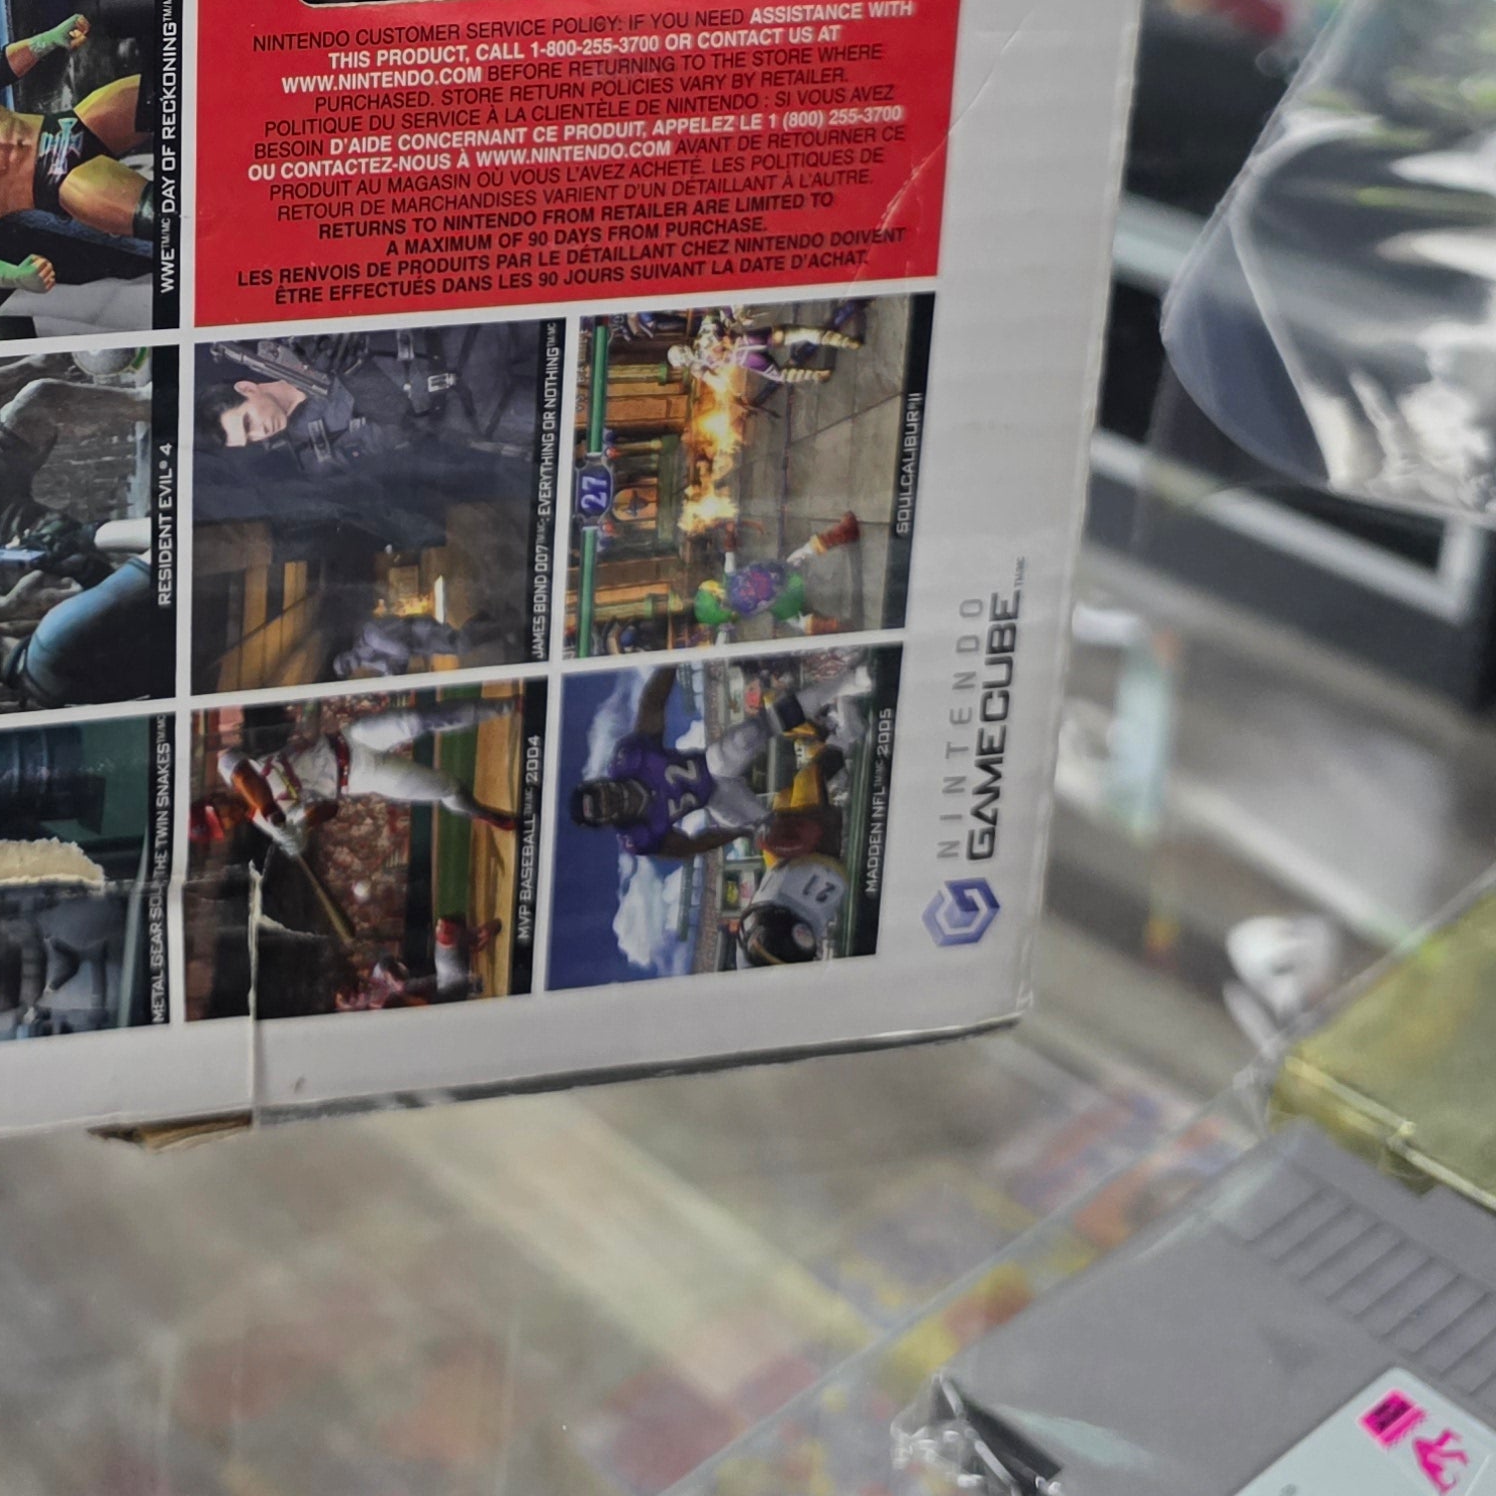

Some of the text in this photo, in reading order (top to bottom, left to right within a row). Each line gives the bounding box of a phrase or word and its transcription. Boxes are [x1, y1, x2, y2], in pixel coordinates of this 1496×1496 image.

[749, 0, 914, 25] ASSISTANCE WITH
[327, 23, 842, 70] THIS PRODUCT, CALL 1-800-255-3700 OR CONTACT US AT
[161, 144, 176, 172] OF
[161, 175, 176, 214] DAY
[318, 190, 835, 240] RETURNS TO NINTENDO FROM RETAILER ARE LIMITED TO
[159, 442, 173, 456] 4
[580, 475, 609, 509] 27
[157, 512, 173, 606] RESIDENT
[532, 410, 557, 660] JAMES BOND EVERYTHING OR
[936, 598, 985, 860] NINTENDO
[966, 592, 1021, 862] GAMECUBE
[865, 707, 893, 893] MADDEN 2005
[517, 735, 541, 940] MVP 2004
